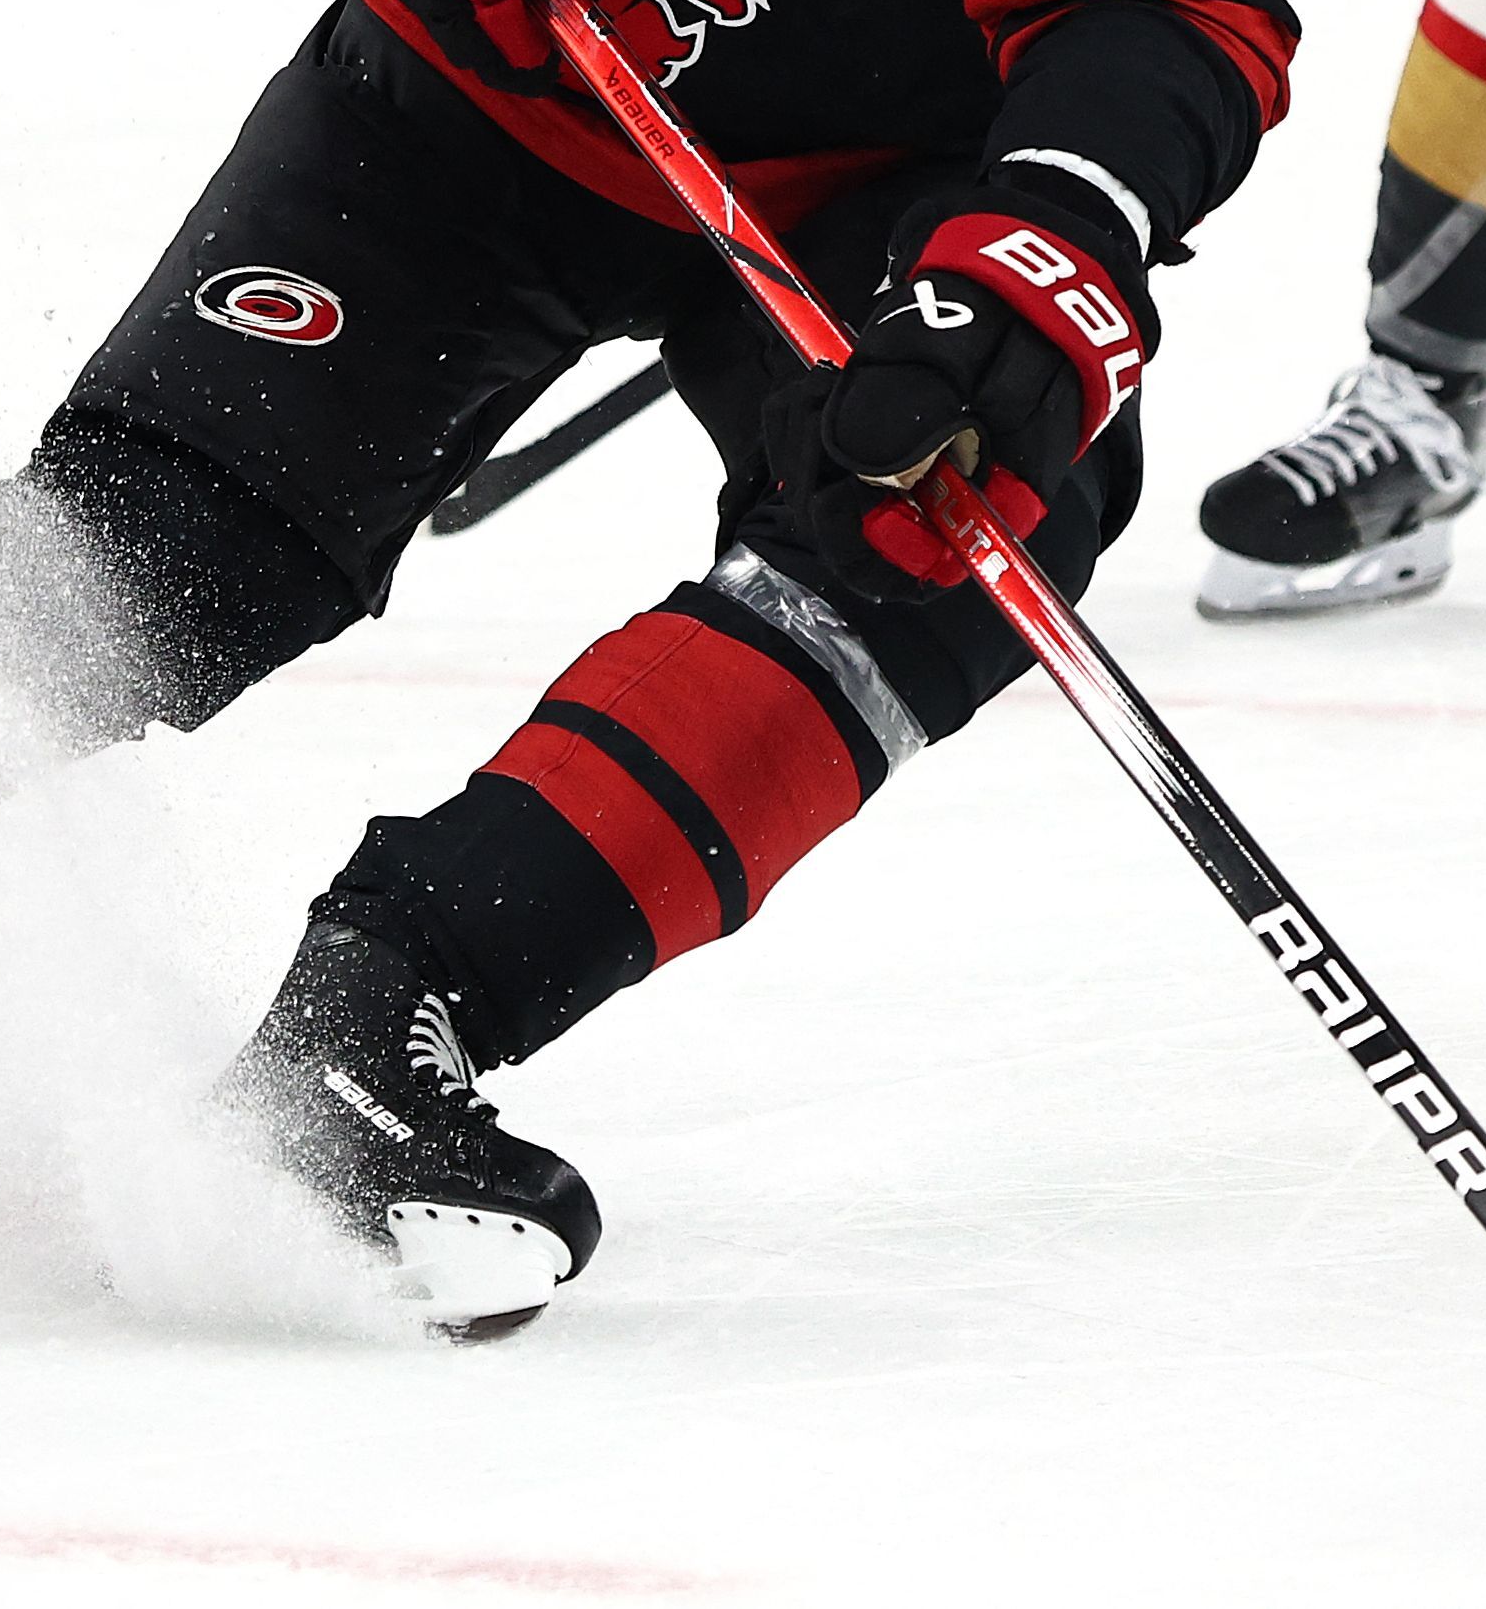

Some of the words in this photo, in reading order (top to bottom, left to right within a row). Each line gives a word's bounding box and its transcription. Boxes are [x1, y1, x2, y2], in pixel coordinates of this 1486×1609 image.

[611, 88, 677, 160] BAUER
[978, 228, 1142, 443] BAU
[324, 1068, 415, 1143] BAUER
